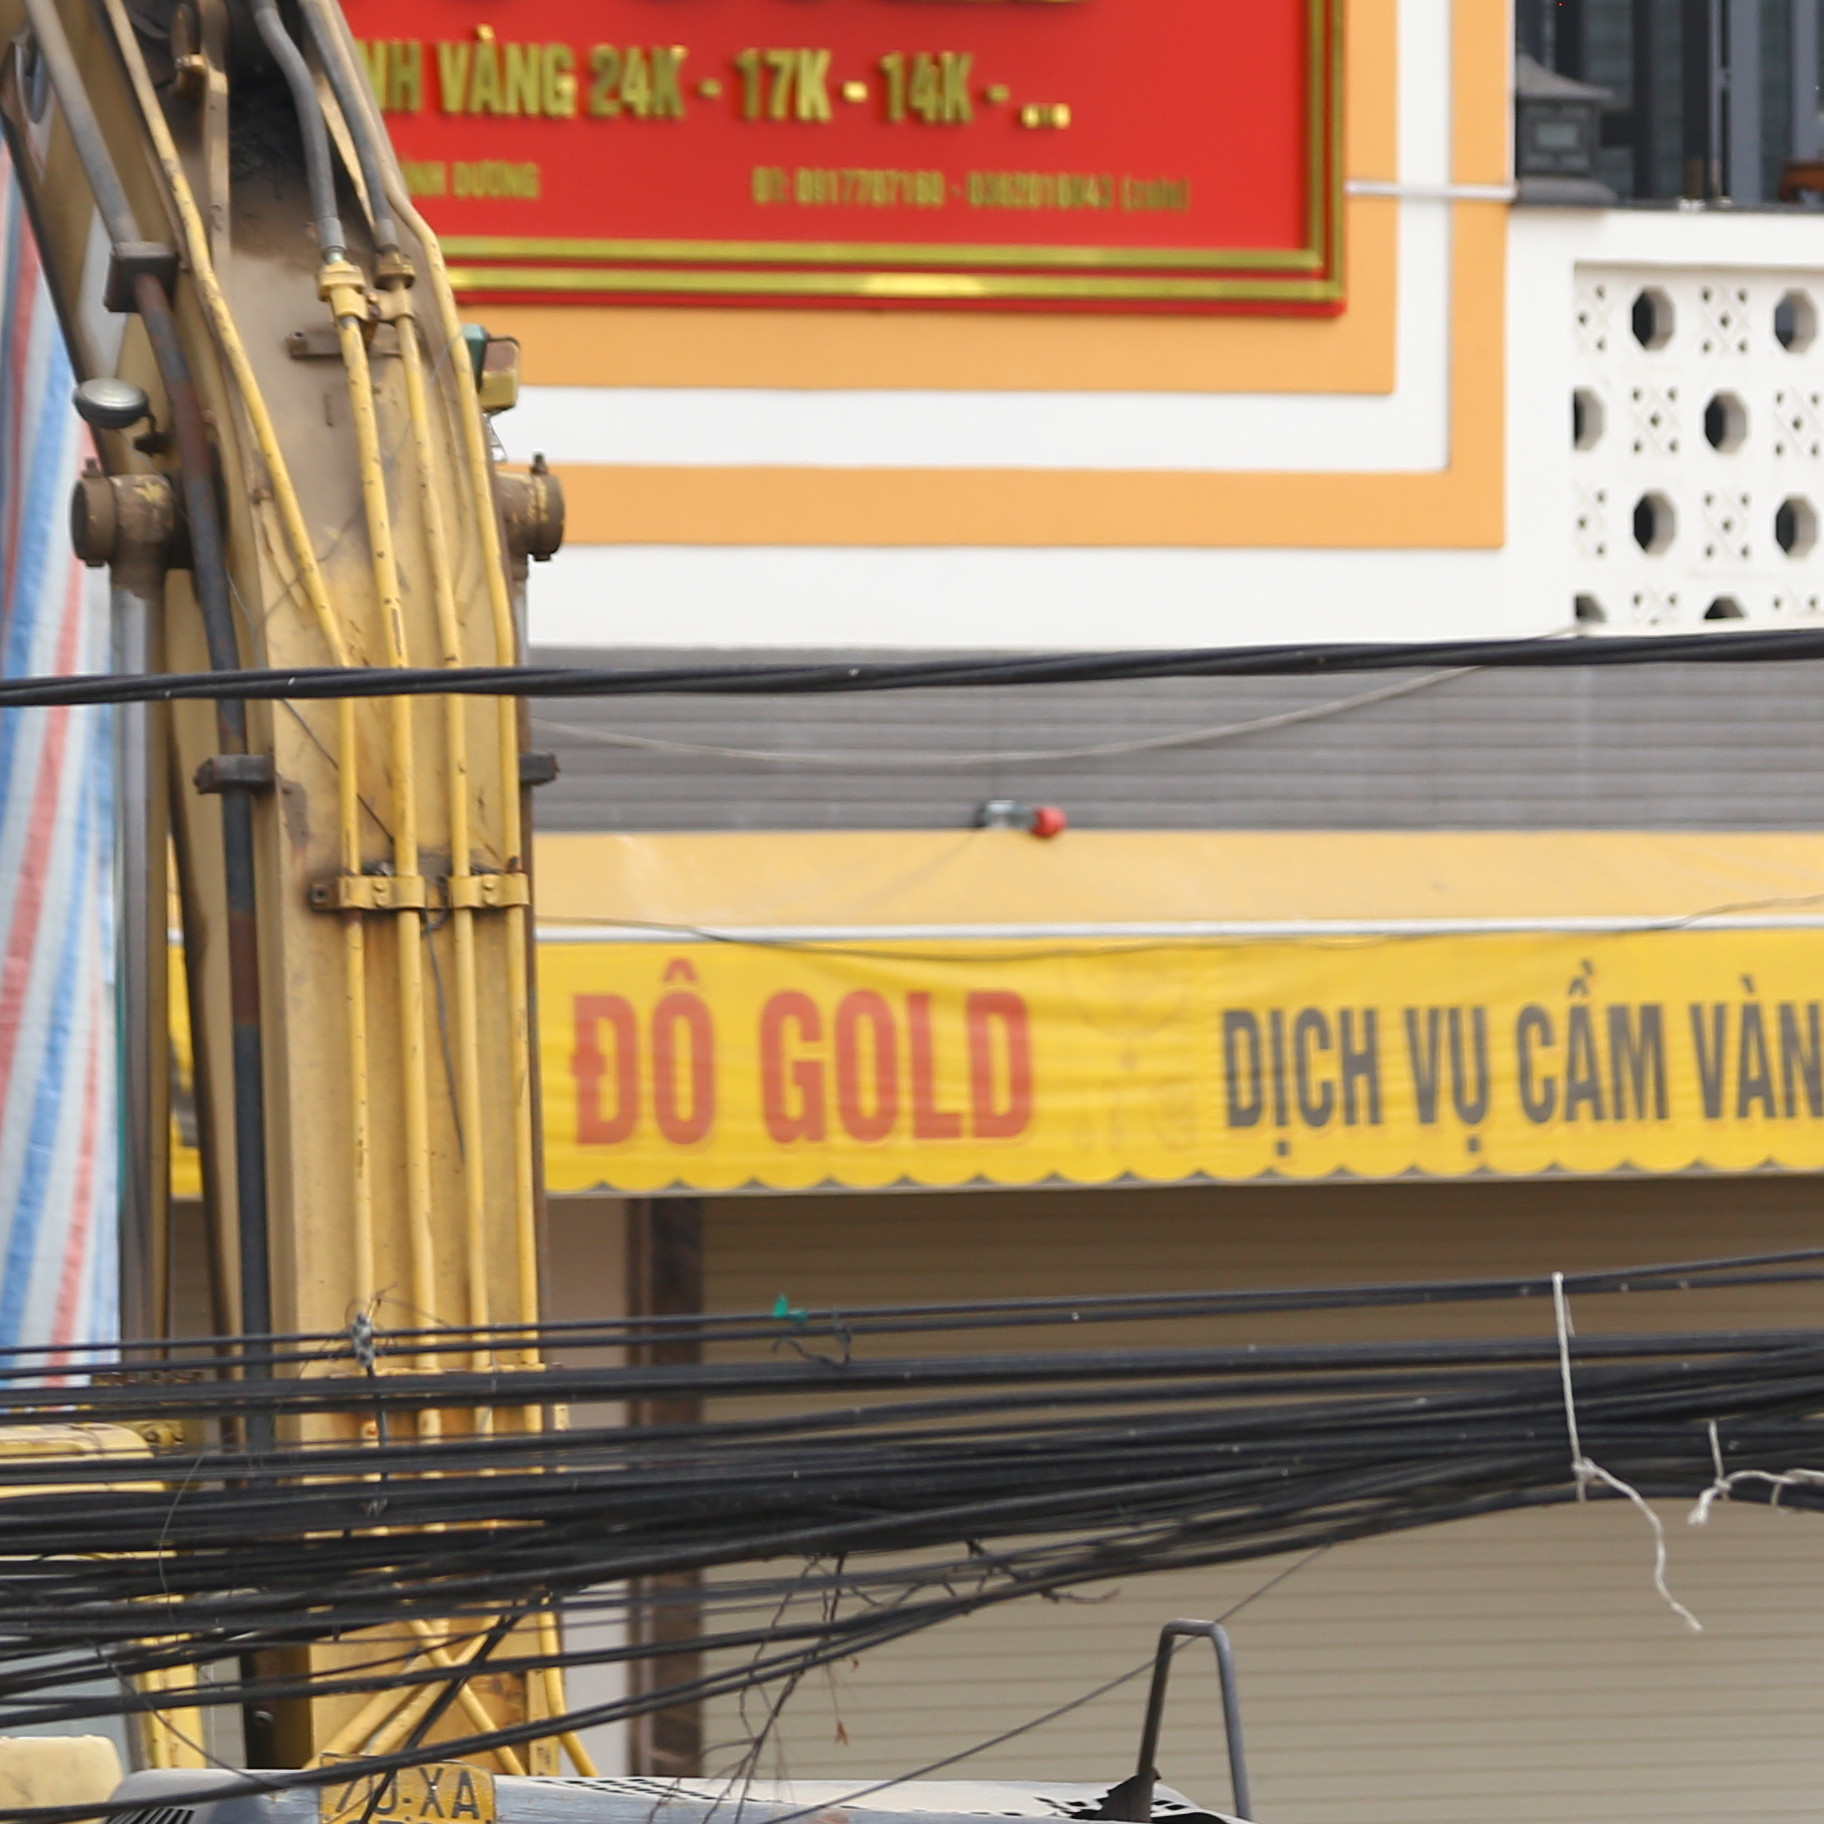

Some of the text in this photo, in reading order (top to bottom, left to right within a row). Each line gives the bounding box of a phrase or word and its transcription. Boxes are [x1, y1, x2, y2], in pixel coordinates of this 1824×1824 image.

[353, 38, 423, 113] NH
[437, 23, 578, 118] VÀNG
[589, 43, 688, 119] 24K
[736, 47, 833, 123] 17K
[880, 50, 974, 125] 14K
[570, 957, 1033, 1146] ĐÔ GOLD
[1222, 1007, 1382, 1157] DỊCH
[1404, 1006, 1490, 1153] VỤ
[1515, 961, 1668, 1124] CẦM
